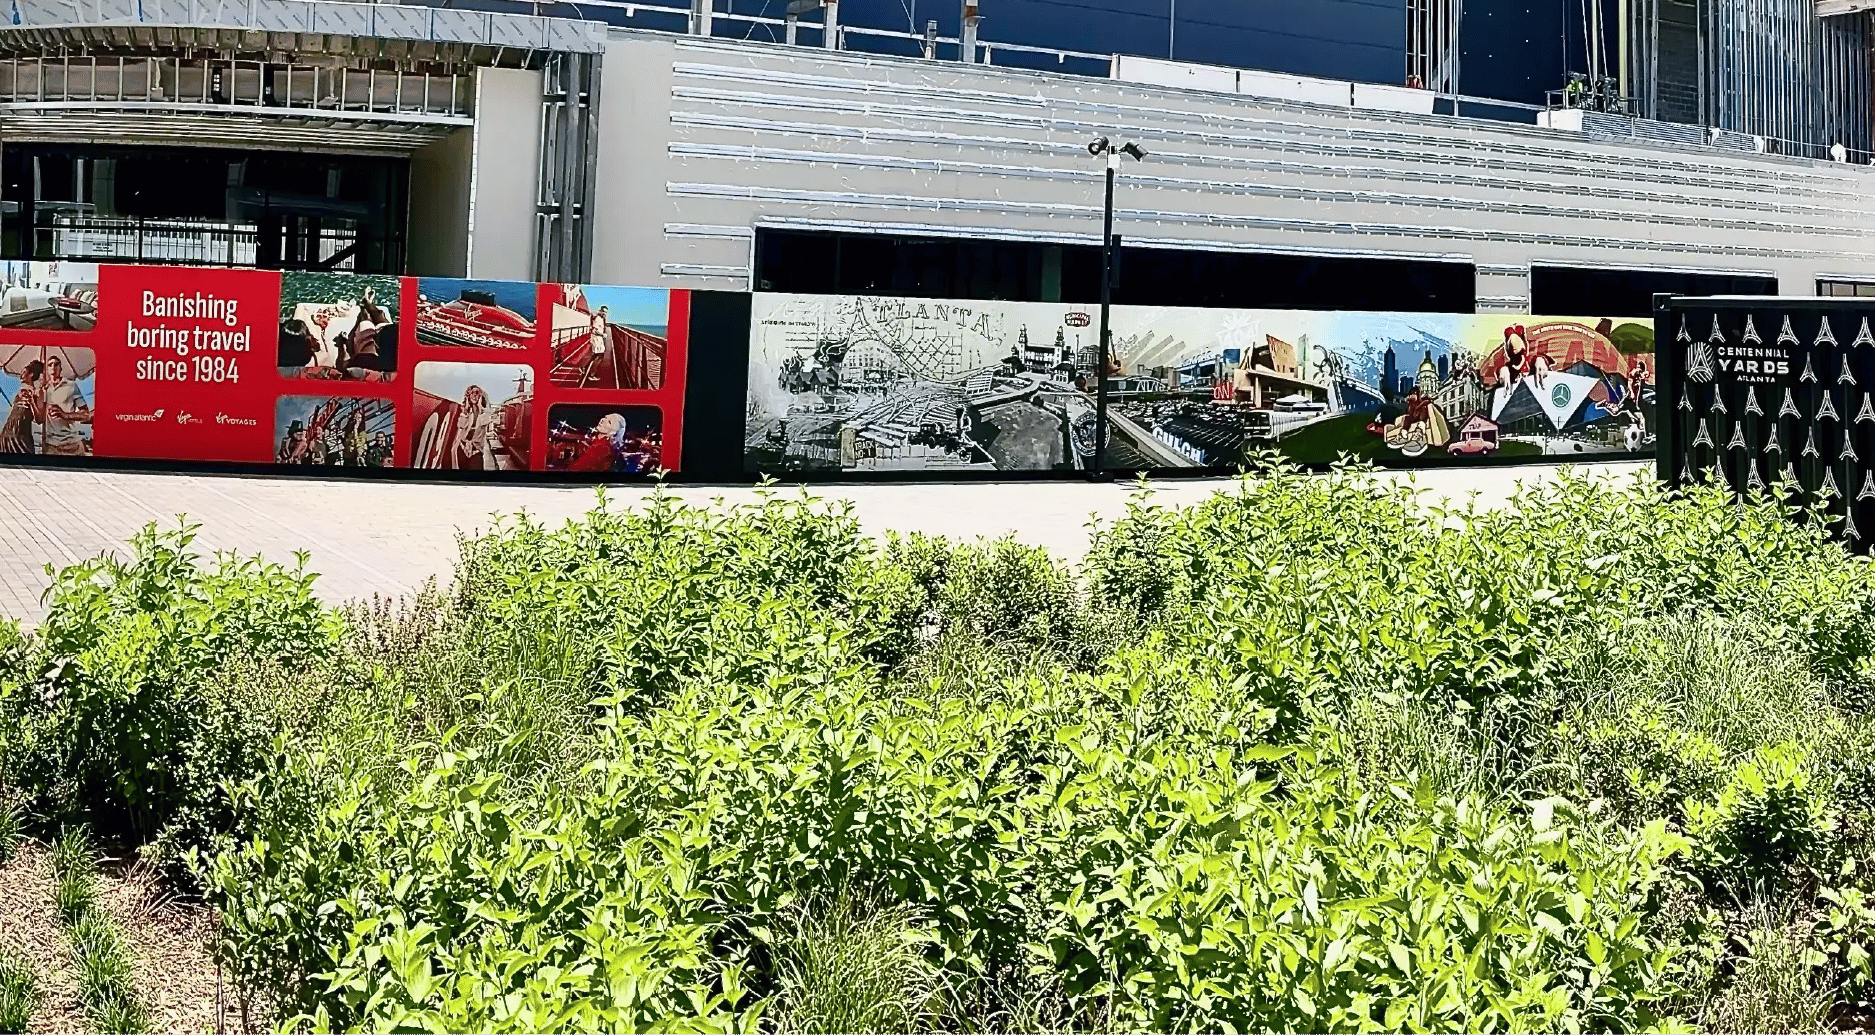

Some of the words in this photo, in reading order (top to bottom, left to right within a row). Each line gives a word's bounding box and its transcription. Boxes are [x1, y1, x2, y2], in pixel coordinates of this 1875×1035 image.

[142, 290, 238, 326] Banishing
[127, 320, 190, 356] boring
[193, 325, 251, 352] travel
[1717, 347, 1789, 359] CENTENNIAL
[136, 355, 187, 381] since
[191, 356, 239, 384] 1984
[1718, 359, 1789, 375] YARDS
[1737, 375, 1776, 383] ATLANTA
